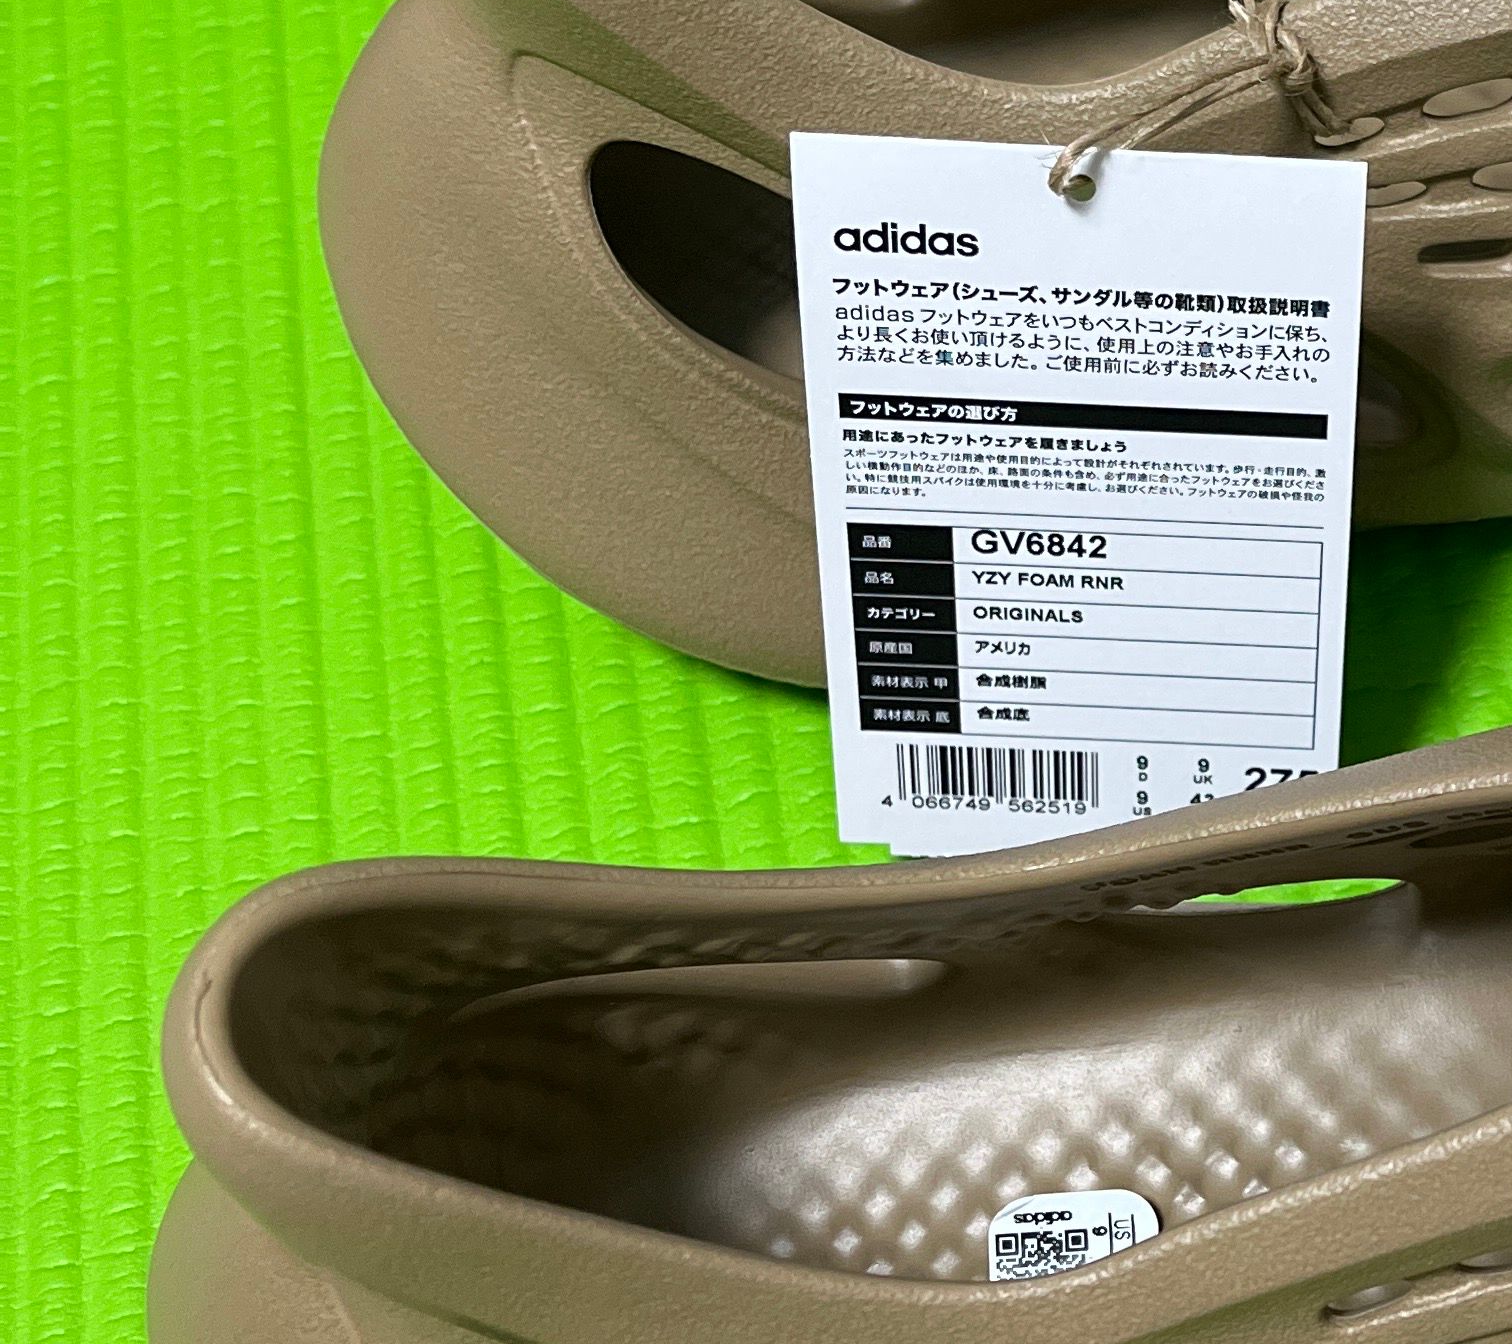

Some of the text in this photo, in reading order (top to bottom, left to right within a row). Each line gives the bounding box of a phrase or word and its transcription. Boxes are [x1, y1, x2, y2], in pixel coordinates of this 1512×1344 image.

[834, 222, 980, 257] adidas
[835, 304, 915, 323] adidas
[836, 325, 1331, 363] より長くお使い頂けるように、使用上の注意やお手入れの
[836, 346, 1318, 384] 方法などを集めました。ご使用前に必ずお読みください。
[849, 400, 1018, 422] フットウェアの選び方
[842, 429, 1128, 453] 用途にあったフットウェアを履きましょう
[845, 484, 926, 498] 原因になります。
[862, 535, 892, 549] 品番
[971, 529, 1107, 559] GV6842
[864, 571, 894, 584] 品名
[972, 571, 1124, 591] YZY FOAM RNR
[867, 607, 936, 621] カテゴリー
[973, 606, 1084, 624] ORIGINALS
[869, 641, 913, 655] 原産国
[975, 640, 1031, 656] アメリカ
[976, 673, 1047, 690] 合成樹脂
[977, 706, 1030, 722] 合成底
[1136, 755, 1148, 770] 9
[1197, 758, 1210, 773] 9
[1193, 774, 1213, 785] UK
[1244, 767, 1319, 791] 27
[881, 795, 1087, 815] 4 066749 562519
[1136, 791, 1148, 805] 9
[1132, 806, 1152, 816] US
